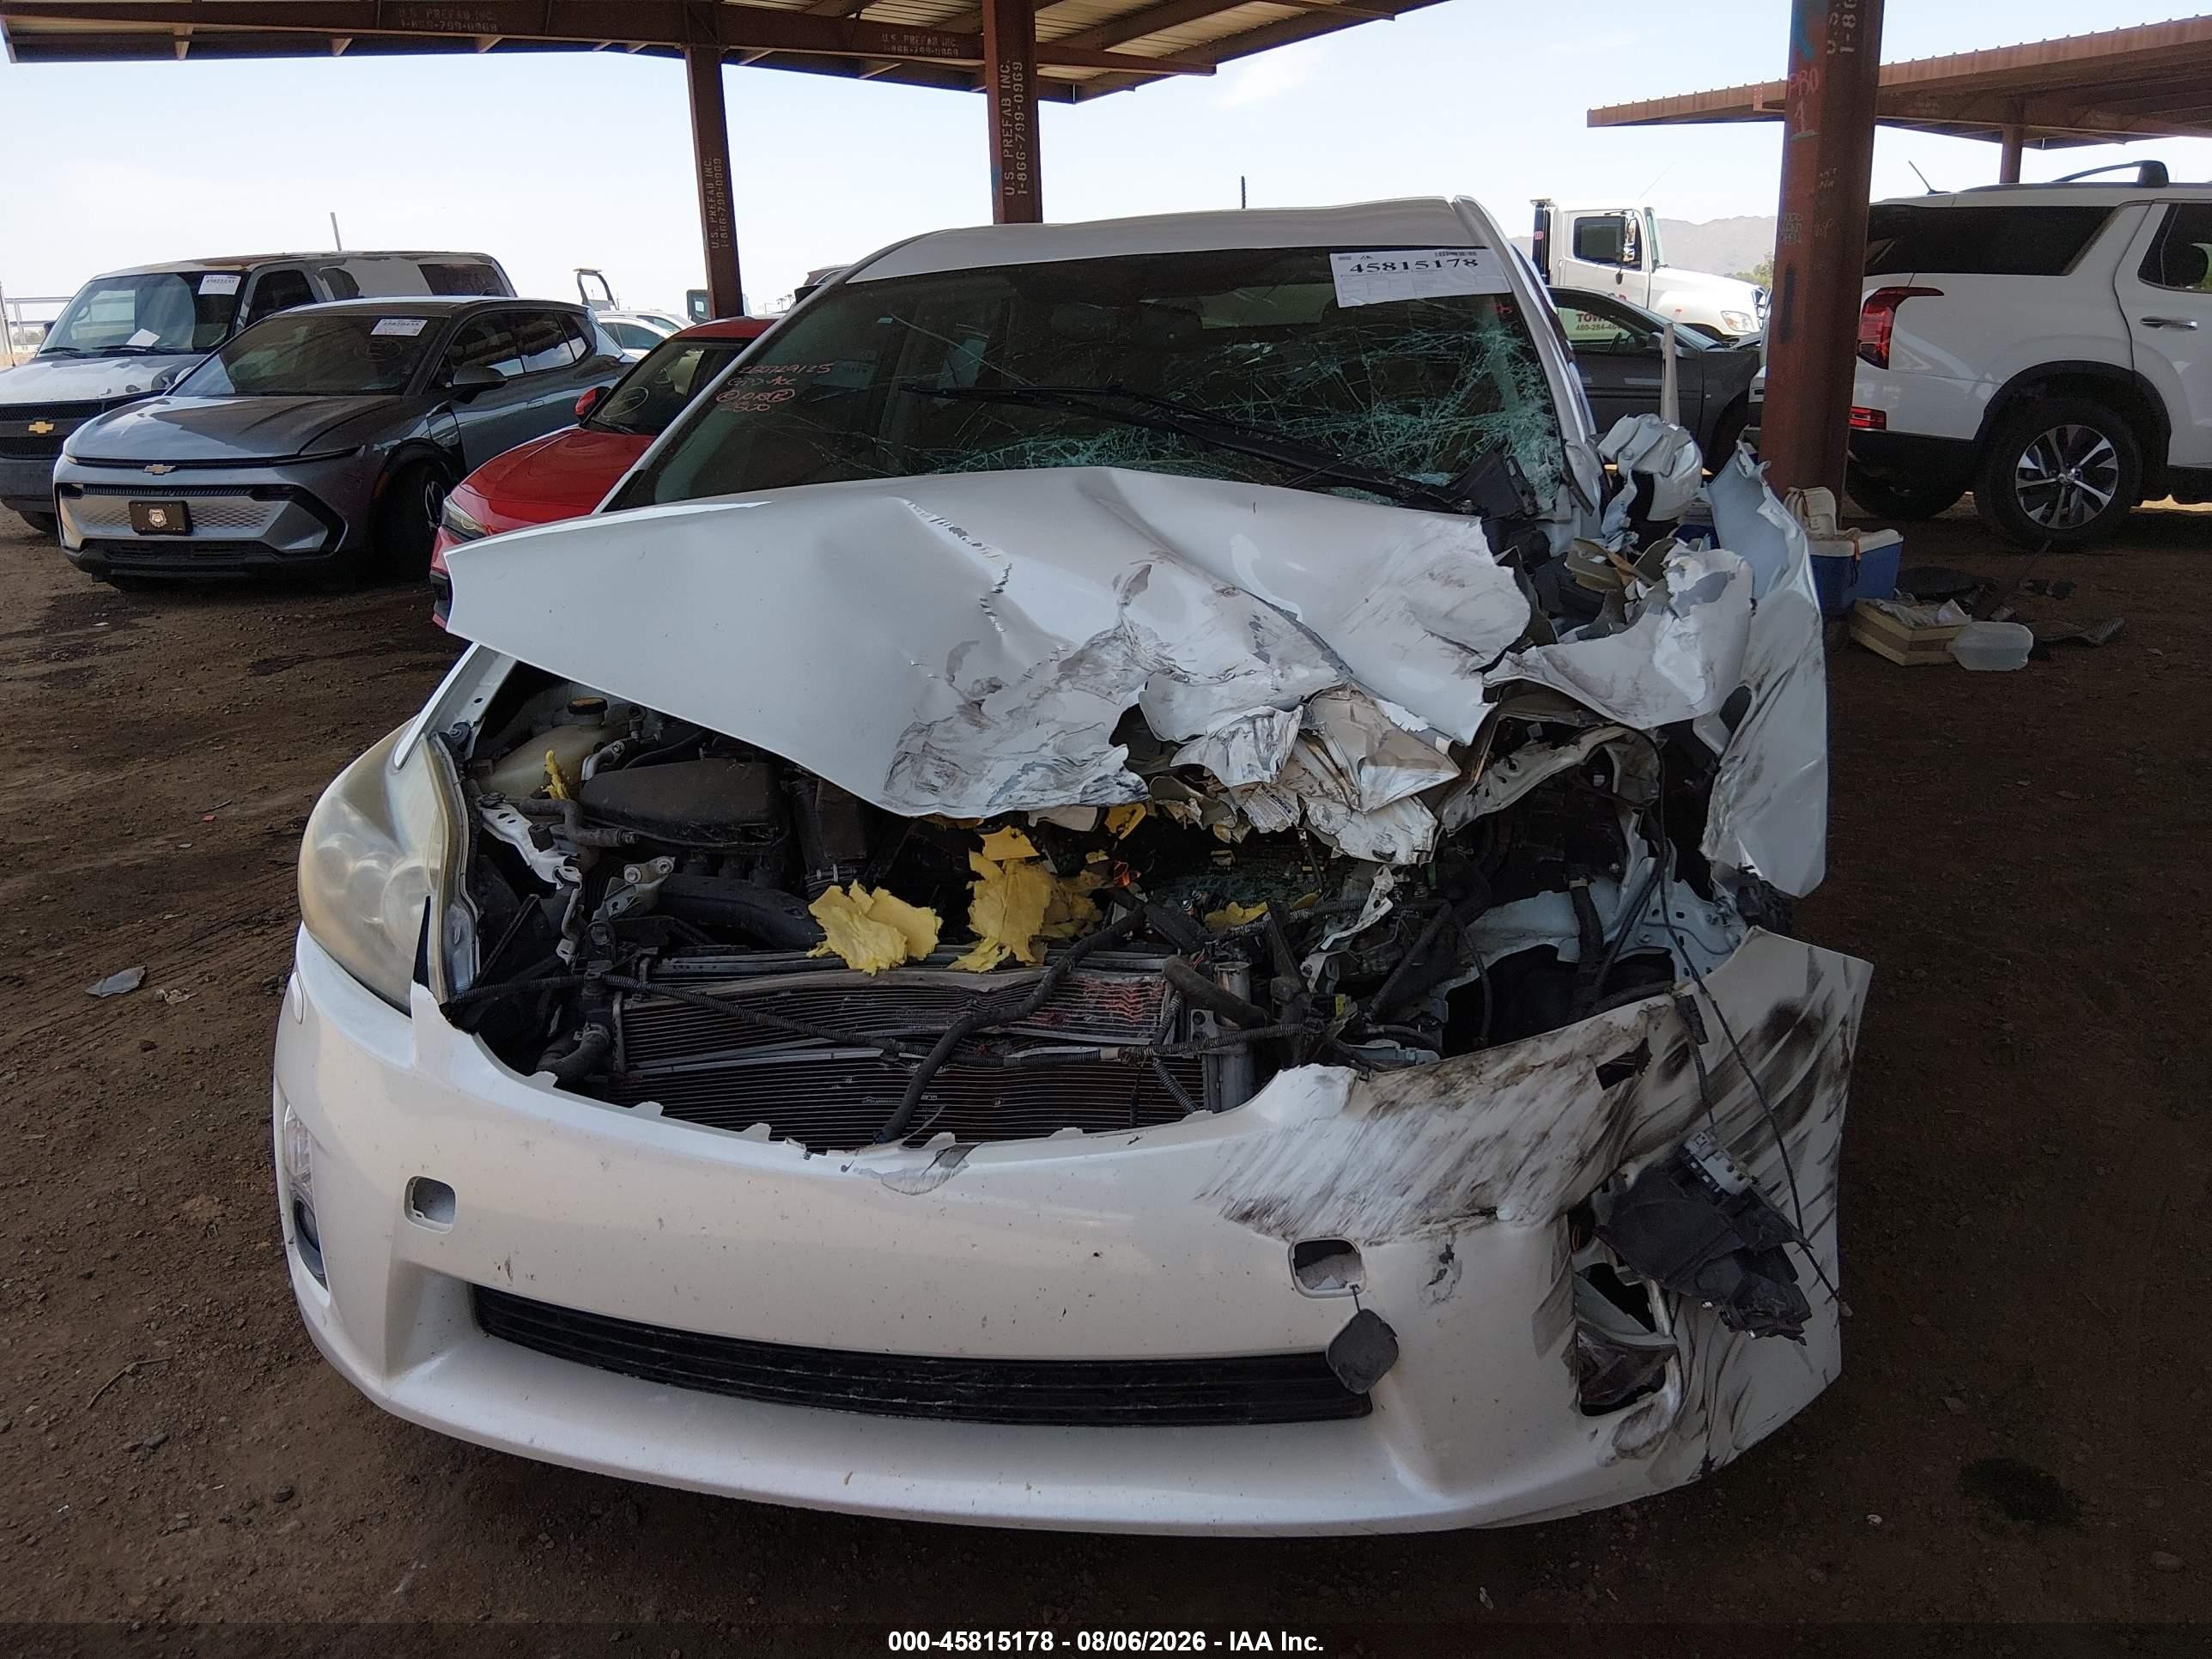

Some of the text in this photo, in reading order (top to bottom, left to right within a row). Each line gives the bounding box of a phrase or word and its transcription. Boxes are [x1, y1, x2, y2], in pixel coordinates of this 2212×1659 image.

[1000, 59, 1012, 89] INC.
[1000, 97, 1014, 158] PREFAB
[1012, 61, 1029, 195] 1-866-799-0969
[706, 182, 719, 223] PREFAB
[1349, 258, 1480, 274] 45815178
